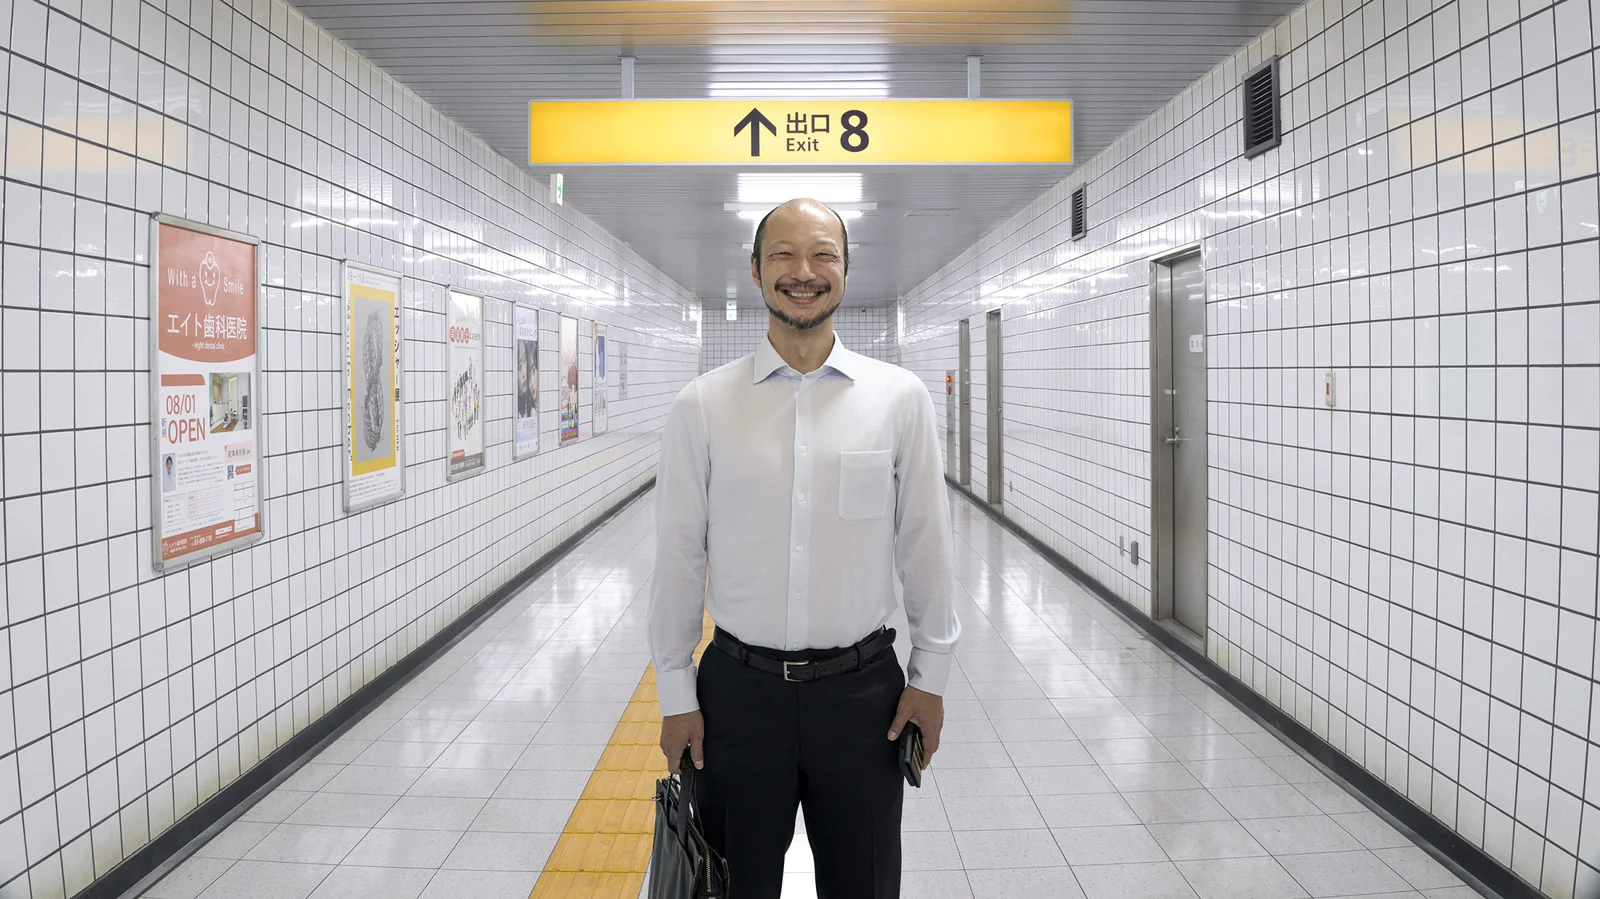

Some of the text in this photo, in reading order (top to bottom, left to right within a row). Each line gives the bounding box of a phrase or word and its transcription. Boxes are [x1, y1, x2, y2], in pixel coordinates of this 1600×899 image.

[786, 109, 870, 153] 出口 8
[786, 137, 819, 152] Exit
[167, 267, 245, 295] With a Smile
[167, 313, 248, 340] エイト歯科医院
[166, 394, 196, 415] 08/01
[168, 417, 206, 444] OPEN
